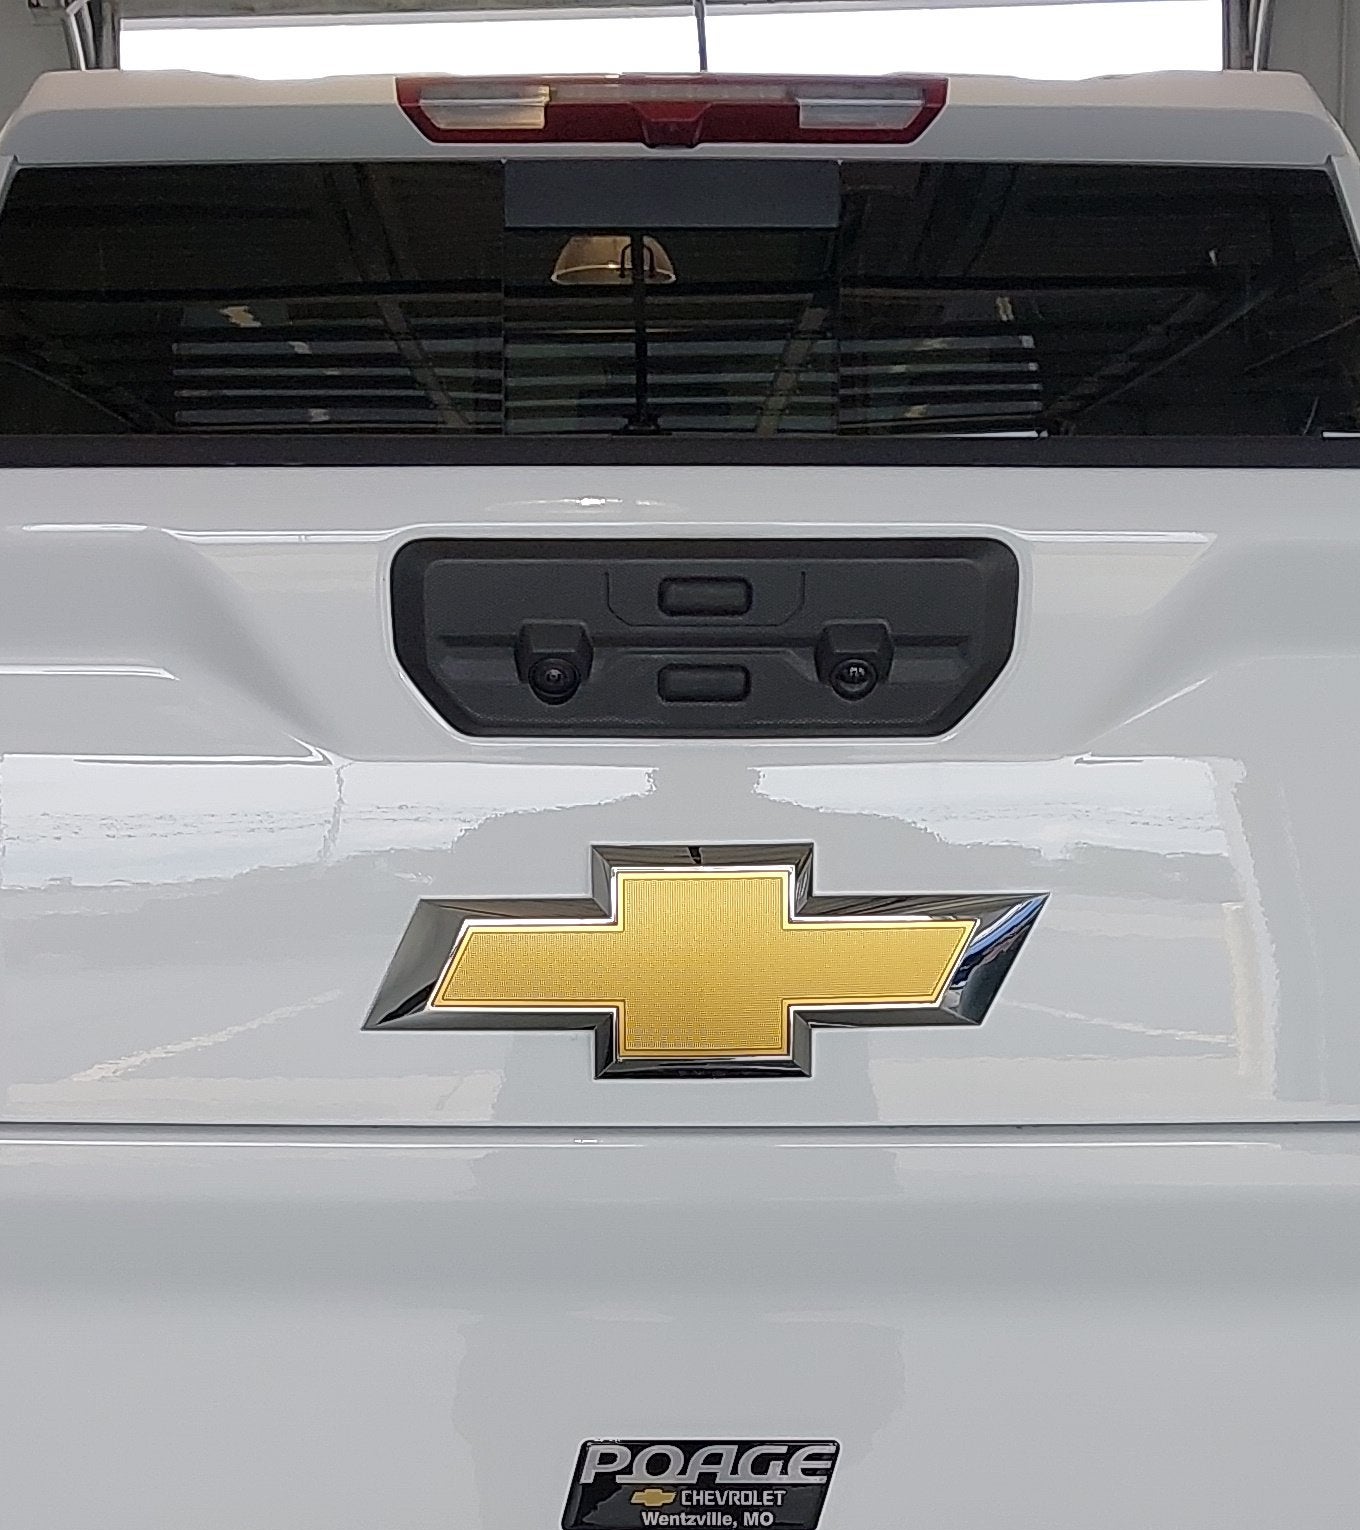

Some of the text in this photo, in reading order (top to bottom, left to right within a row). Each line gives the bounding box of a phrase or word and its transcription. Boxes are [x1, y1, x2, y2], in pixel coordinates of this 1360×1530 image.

[580, 1443, 837, 1485] POAGE
[680, 1489, 787, 1507] CHEVROLET
[641, 1511, 774, 1529] Wentzville, MO
